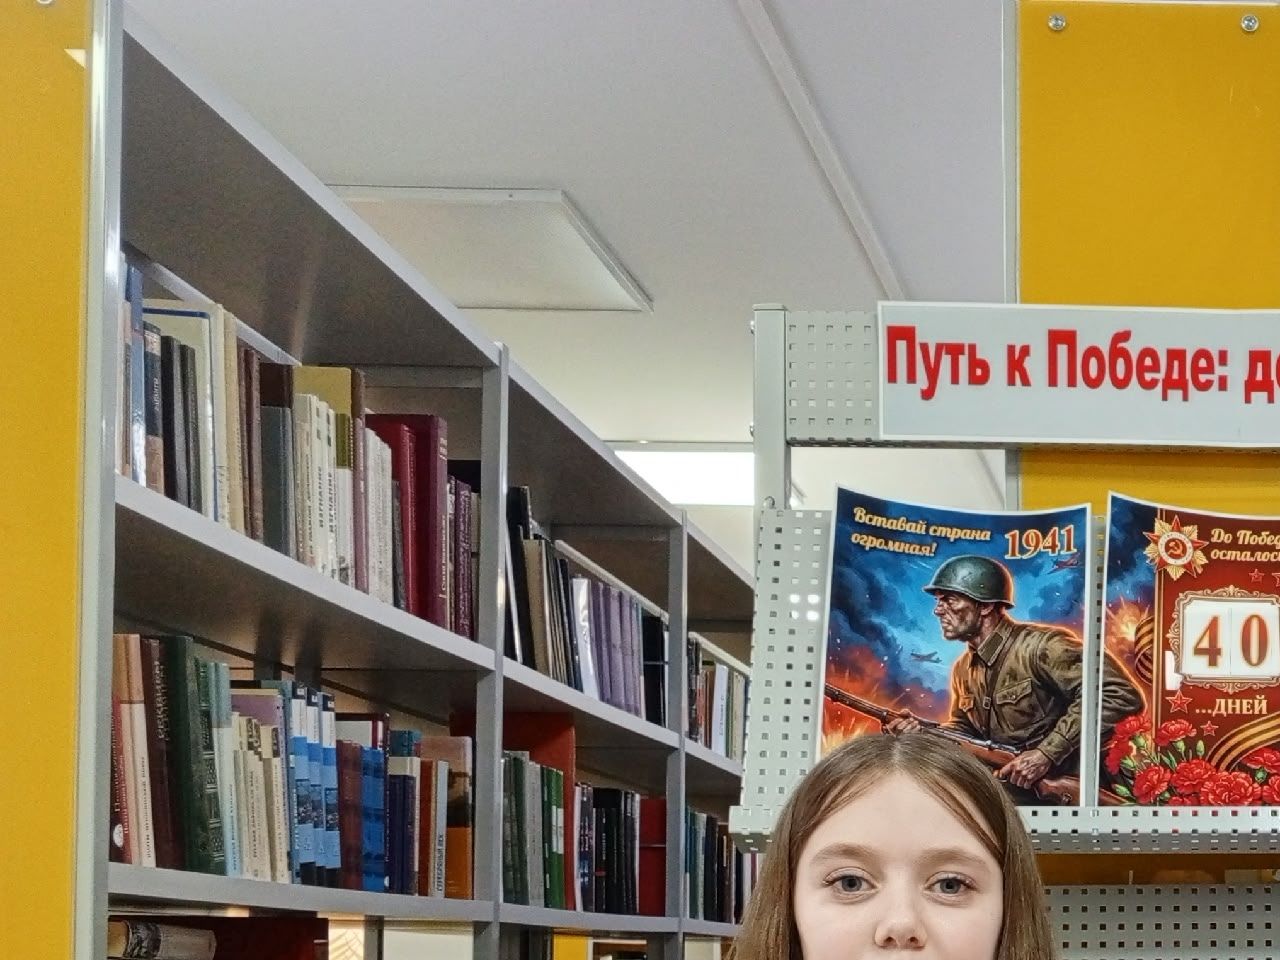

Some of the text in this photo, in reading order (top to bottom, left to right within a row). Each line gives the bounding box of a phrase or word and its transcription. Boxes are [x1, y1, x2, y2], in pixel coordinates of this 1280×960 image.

[886, 325, 991, 401] Путь
[1007, 344, 1031, 387] к
[1048, 329, 1228, 402] Победе:
[853, 506, 992, 542] Вставай страна
[1005, 524, 1078, 560] 1941
[1210, 528, 1232, 544] До
[851, 532, 937, 556] огромная!
[1193, 614, 1270, 668] 40
